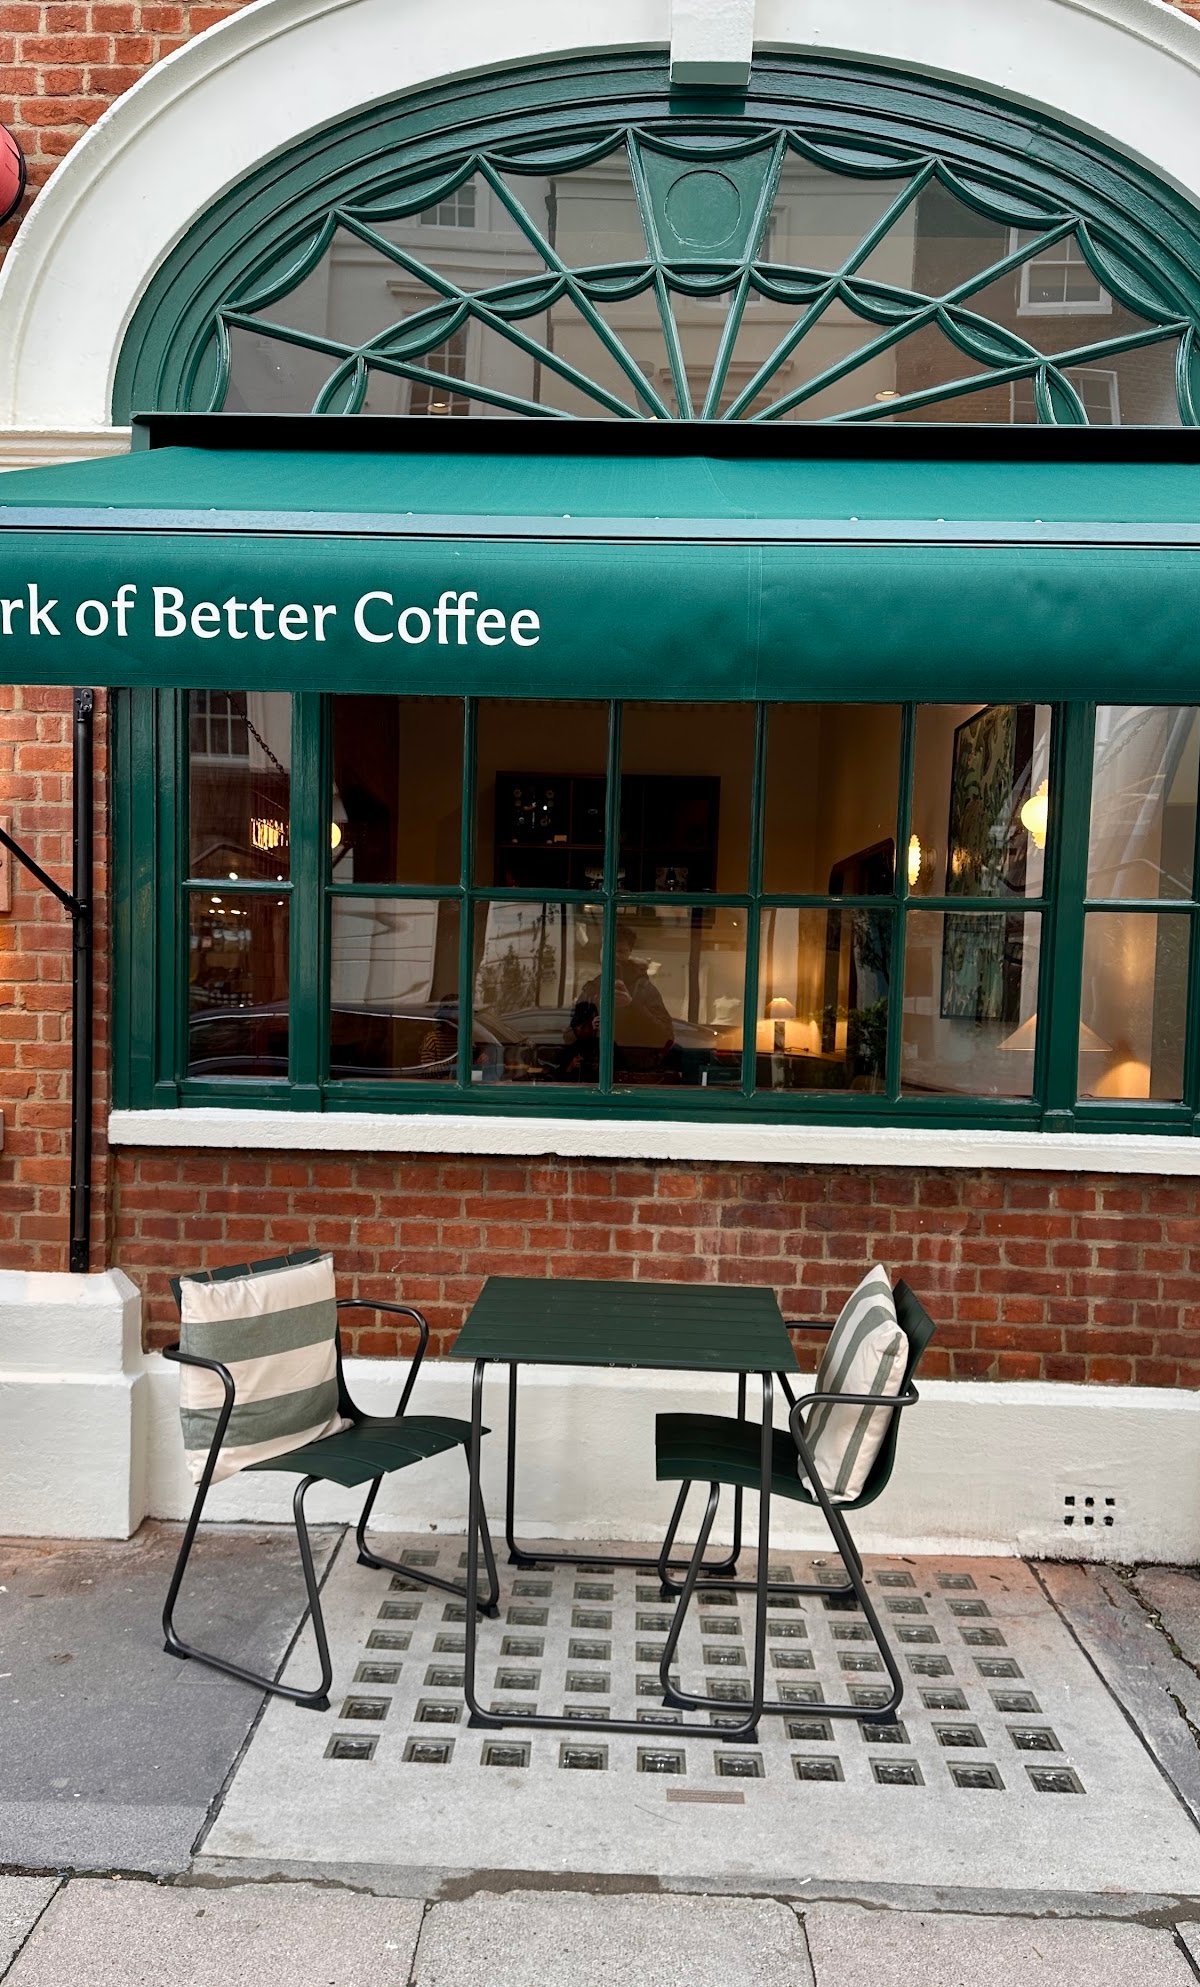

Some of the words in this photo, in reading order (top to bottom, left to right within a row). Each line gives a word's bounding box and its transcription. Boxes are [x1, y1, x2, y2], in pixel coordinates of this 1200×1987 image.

[0, 583, 61, 636] rk
[75, 584, 137, 637] of
[152, 586, 337, 641] Better
[354, 591, 541, 647] Coffee
